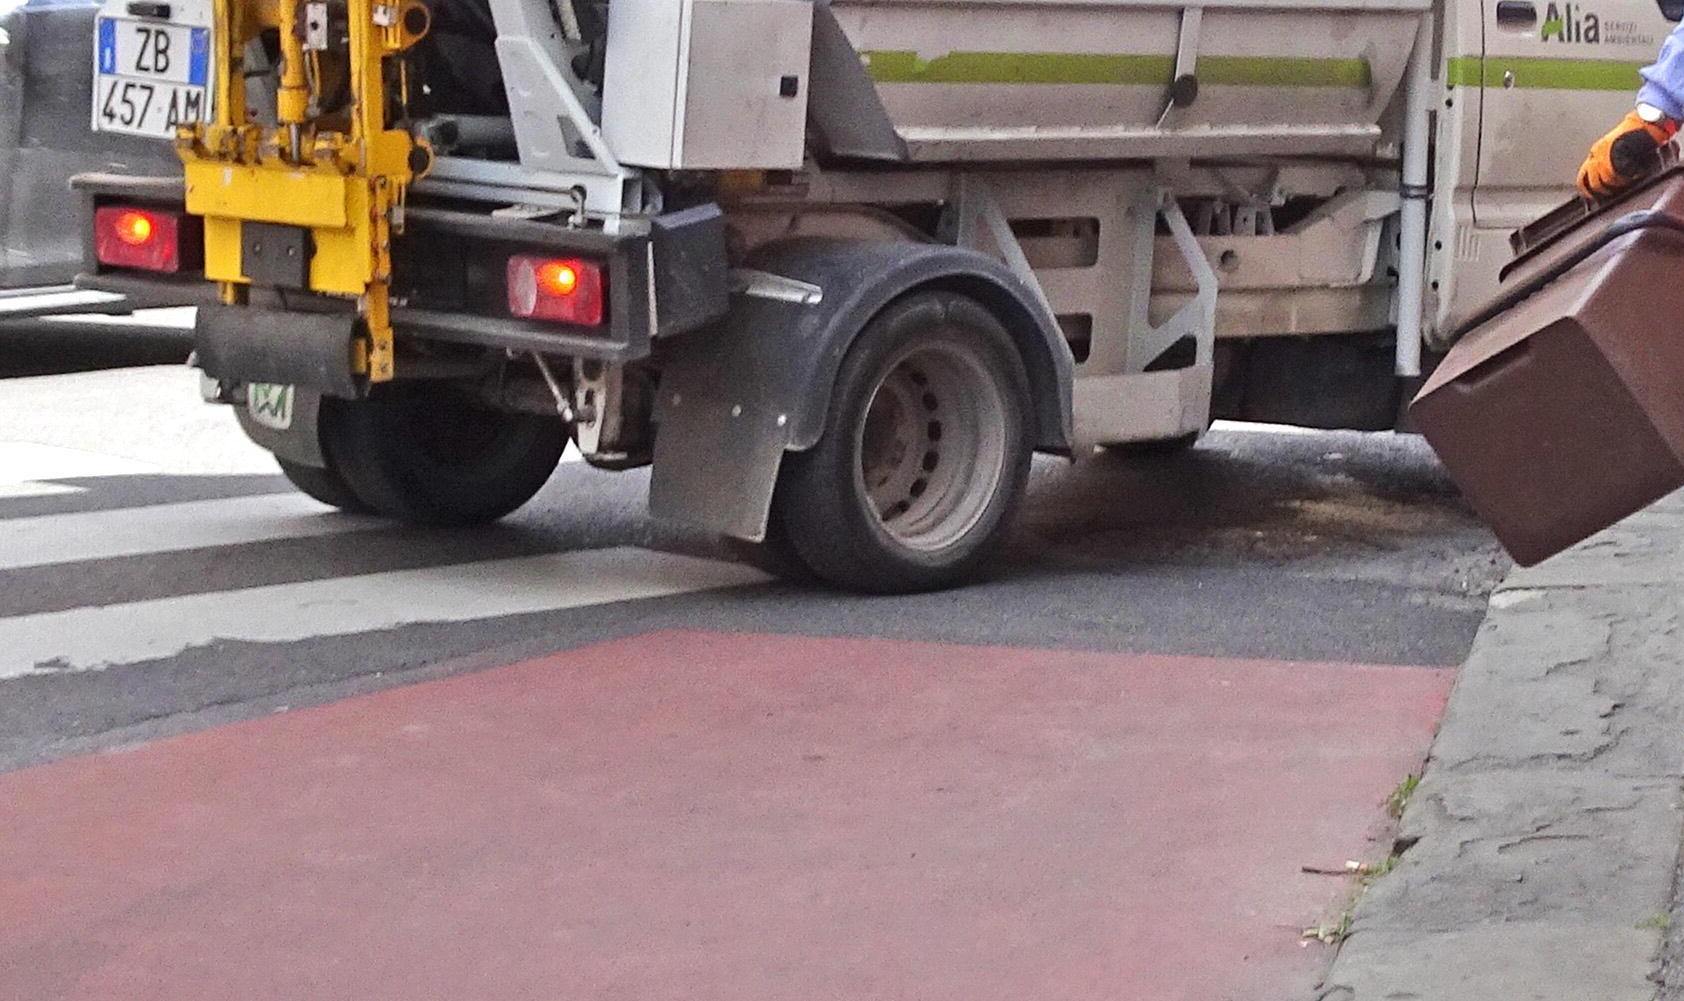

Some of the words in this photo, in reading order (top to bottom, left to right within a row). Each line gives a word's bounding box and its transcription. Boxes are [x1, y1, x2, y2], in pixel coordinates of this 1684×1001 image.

[1541, 1, 1600, 43] Alia
[135, 26, 170, 73] ZB
[102, 81, 155, 129] 457
[165, 88, 201, 131] AM
